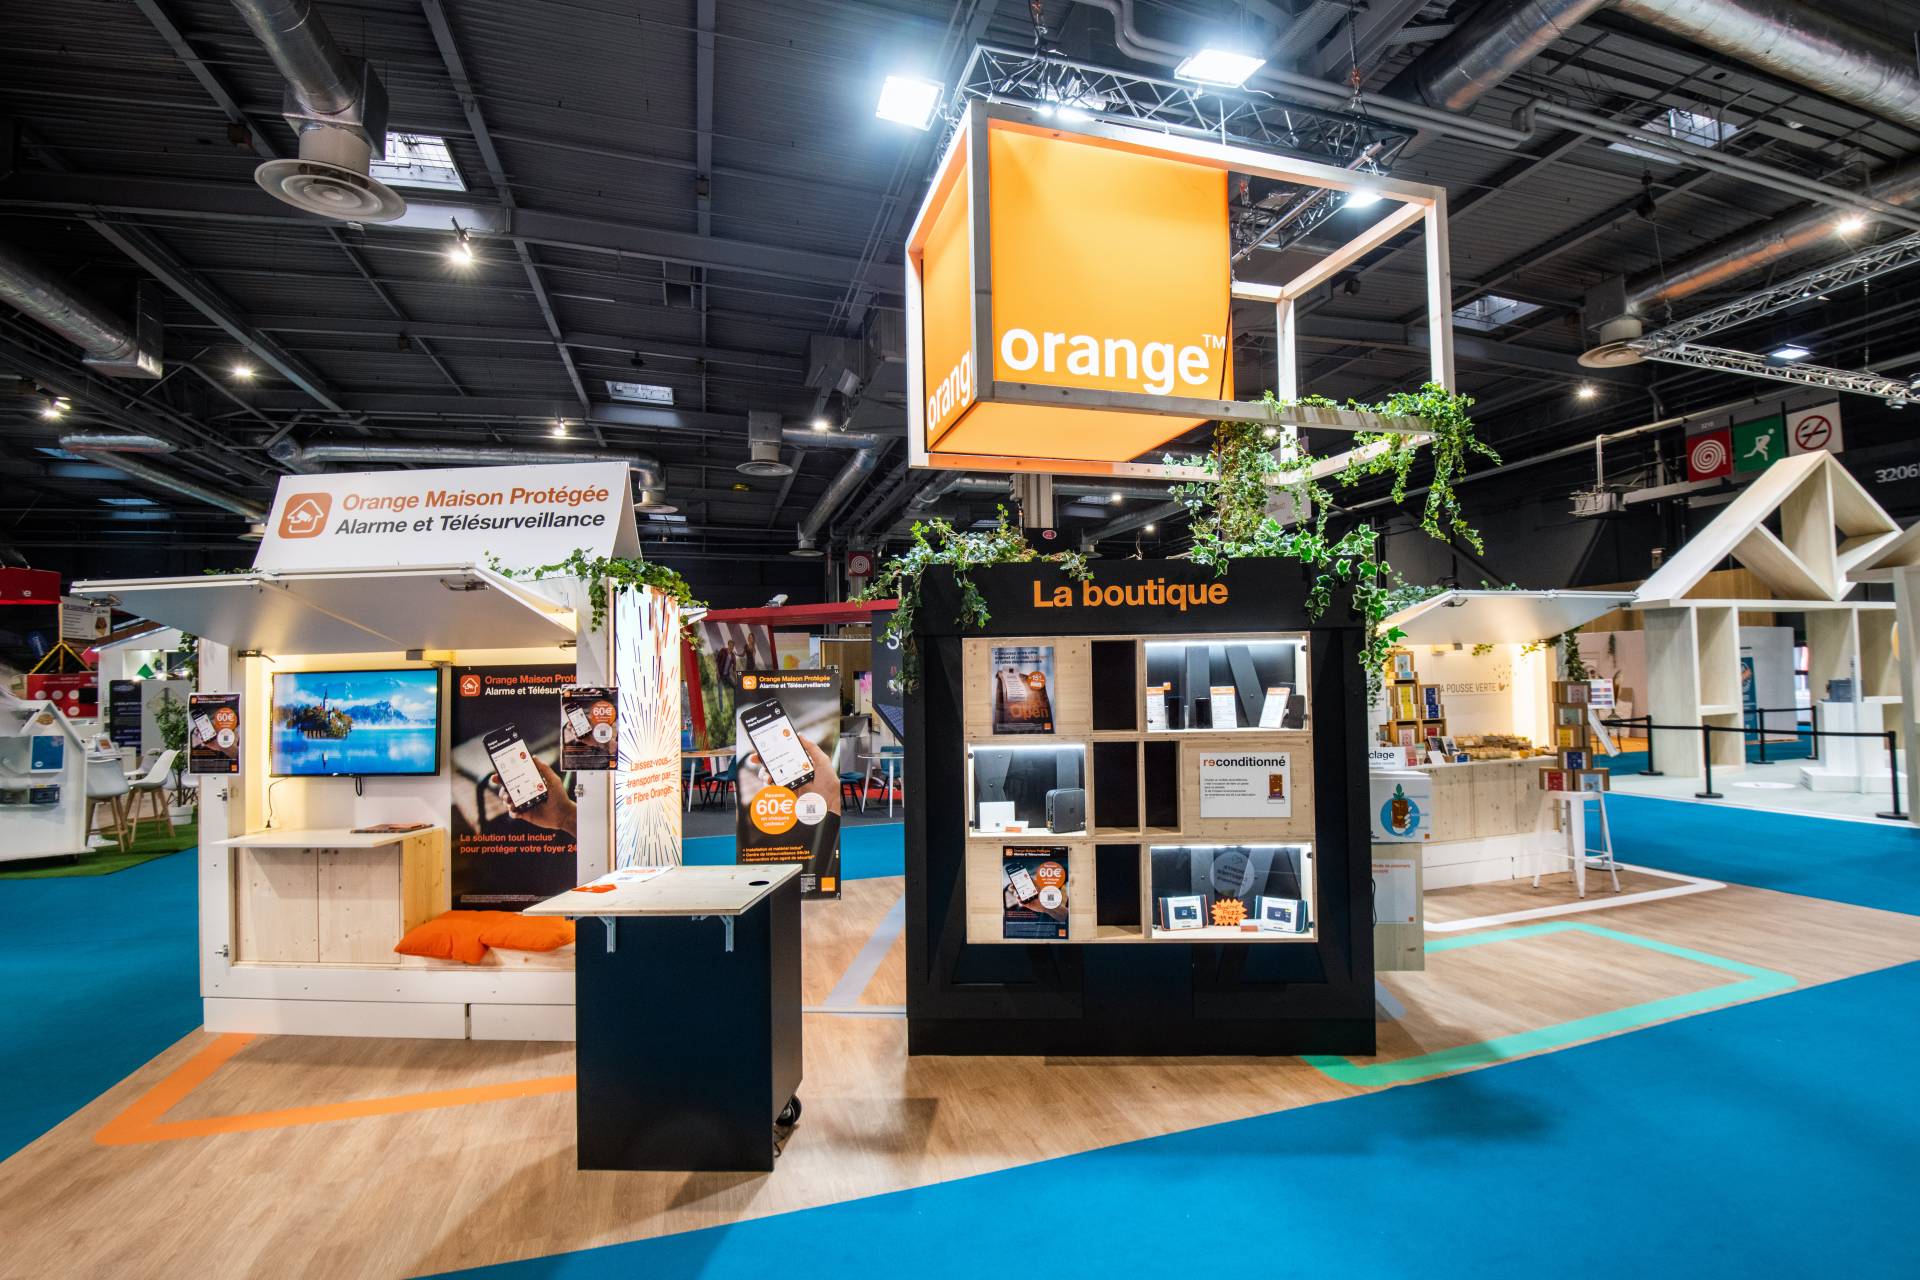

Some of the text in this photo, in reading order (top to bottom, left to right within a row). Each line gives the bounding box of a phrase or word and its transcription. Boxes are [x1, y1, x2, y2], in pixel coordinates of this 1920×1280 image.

[1001, 328, 1210, 395] orange
[928, 349, 973, 431] orang
[342, 485, 609, 513] Orange Maison Protégée
[335, 510, 605, 535] Alarme et Télésurveillance
[1034, 577, 1229, 611] La boutique
[485, 675, 517, 685] Orange
[520, 674, 553, 684] Maison
[804, 674, 831, 682] Protégée
[485, 687, 516, 696] Alarme
[517, 687, 526, 695] et
[1447, 683, 1474, 693] POUSSE
[1475, 682, 1497, 692] VERTE
[592, 707, 613, 716] 60€
[1010, 704, 1049, 721] Open
[216, 713, 235, 722] 60€
[634, 791, 649, 803] Fibre
[755, 799, 793, 815] 60€
[460, 834, 471, 842] La
[473, 833, 506, 841] solution
[508, 833, 526, 841] tout
[460, 846, 480, 854] pour
[482, 844, 517, 854] protéger
[519, 845, 541, 853] votre
[543, 844, 566, 854] foyer
[1039, 867, 1062, 878] 60€
